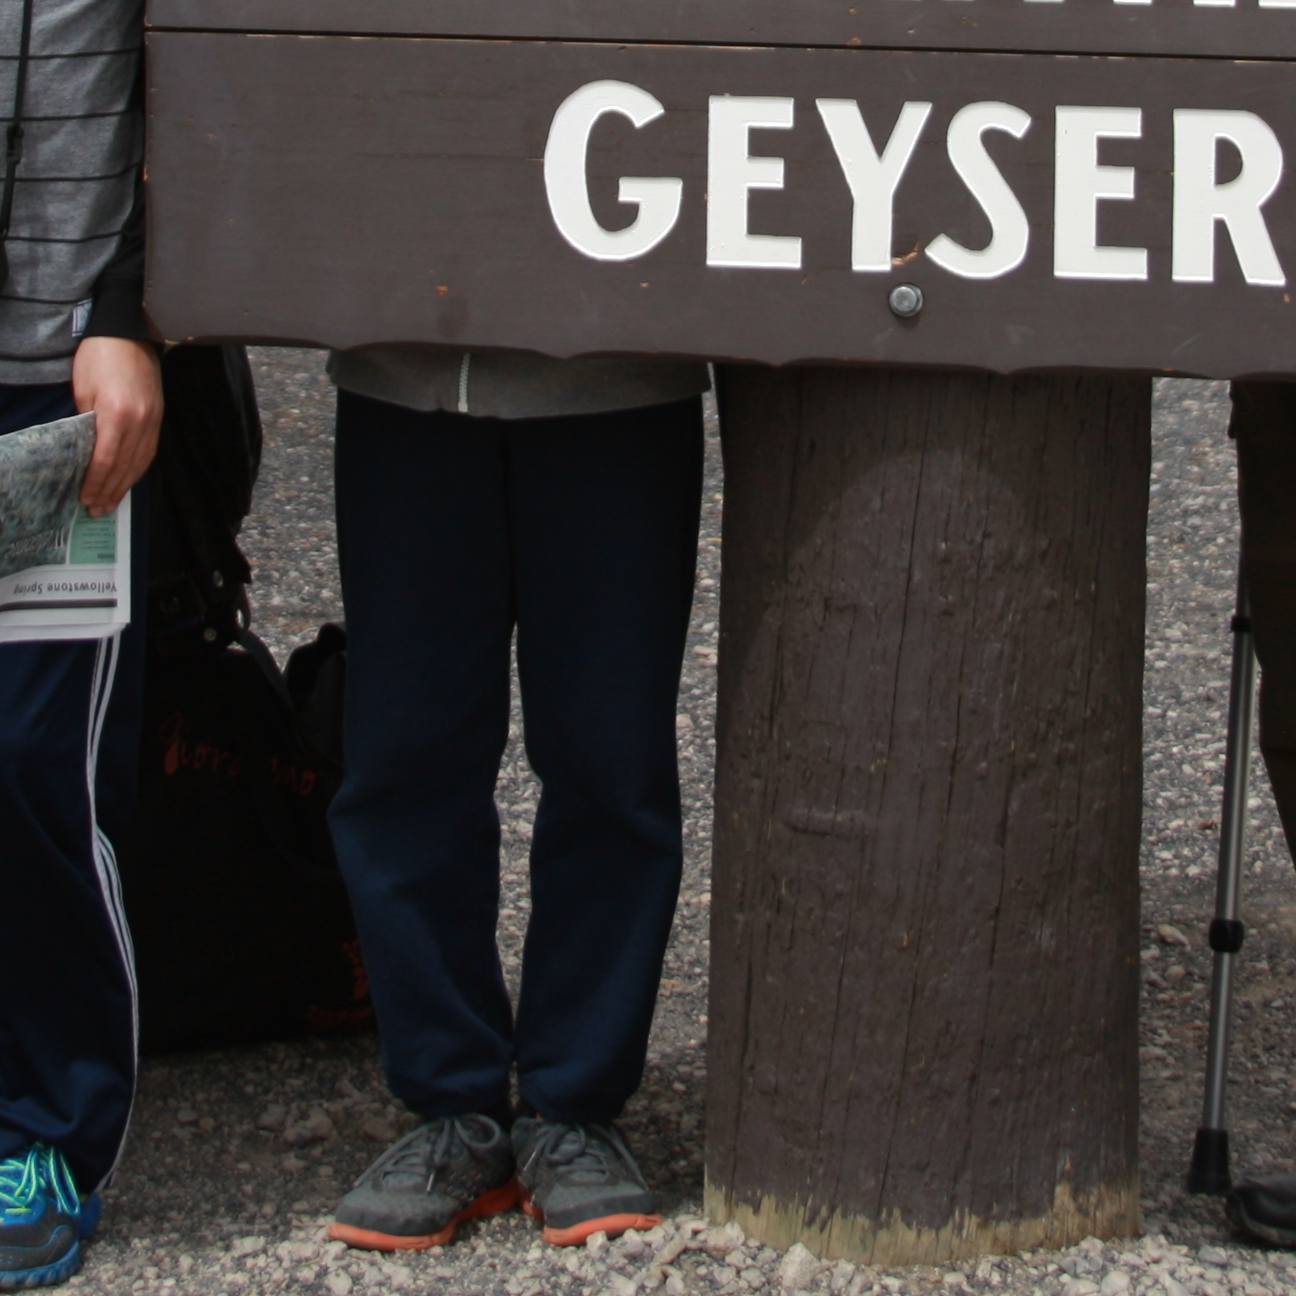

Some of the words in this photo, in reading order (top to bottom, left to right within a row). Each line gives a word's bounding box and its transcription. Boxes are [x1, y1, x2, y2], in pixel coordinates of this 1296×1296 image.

[543, 79, 1287, 287] GEYSER
[13, 582, 43, 595] Spring
[47, 581, 117, 594] Yellowstone
